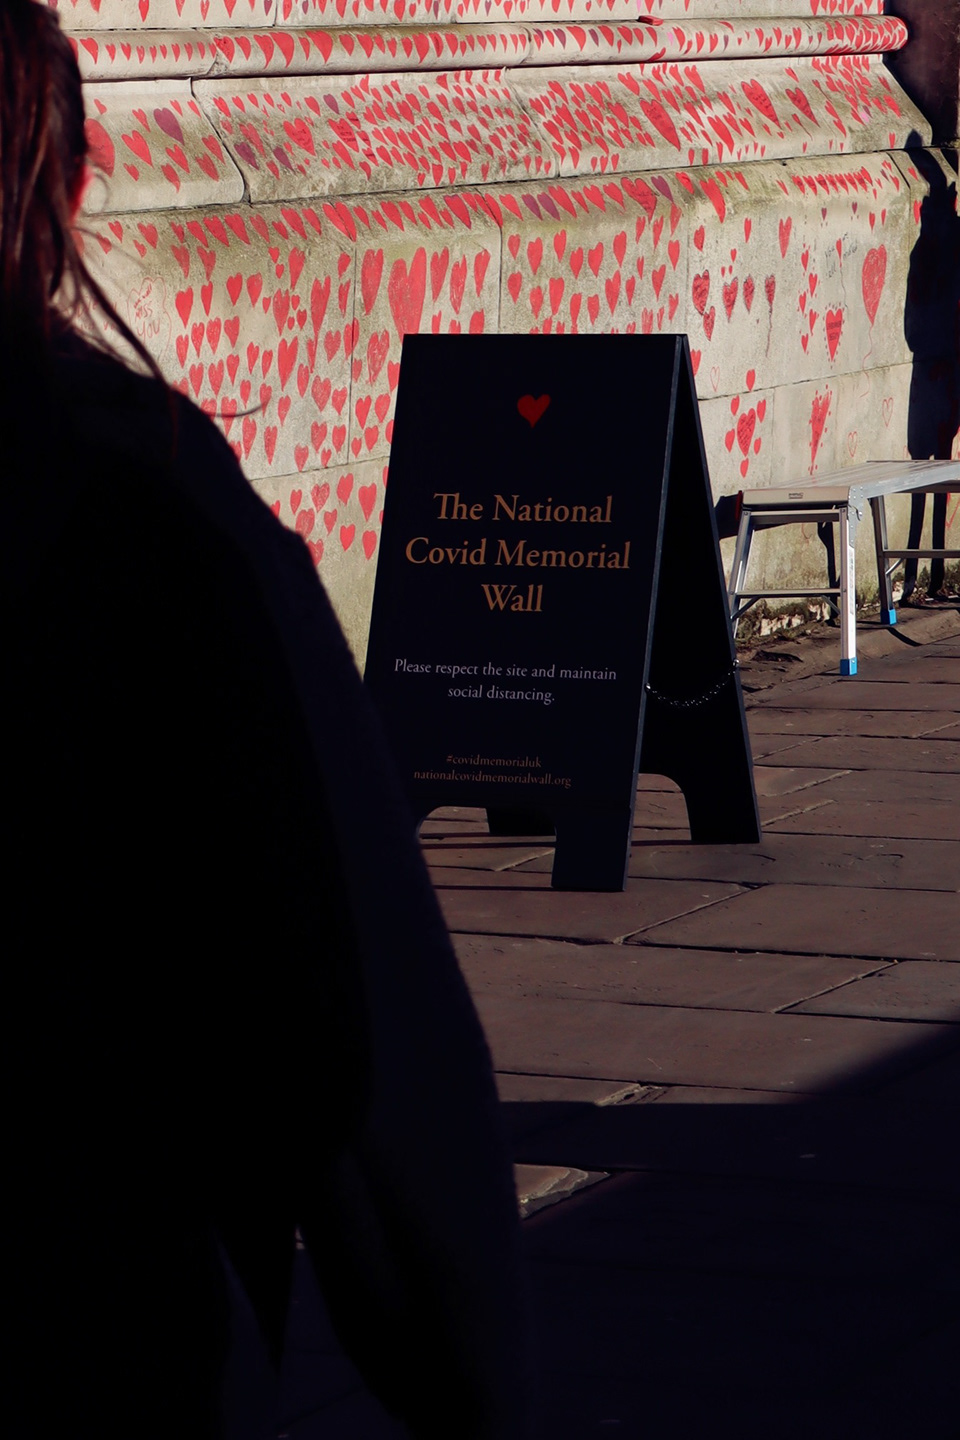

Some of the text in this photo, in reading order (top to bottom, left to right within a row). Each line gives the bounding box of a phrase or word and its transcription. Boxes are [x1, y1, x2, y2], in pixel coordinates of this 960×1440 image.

[433, 492, 613, 523] The National
[405, 537, 631, 569] Covid Memorial
[481, 584, 543, 612] Wall
[394, 658, 617, 681] Please respect the site and maintain
[447, 684, 555, 705] social distancing.
[445, 754, 542, 768] #covidmemorialuk
[413, 769, 572, 788] nationalcovidmemorialwall.org
